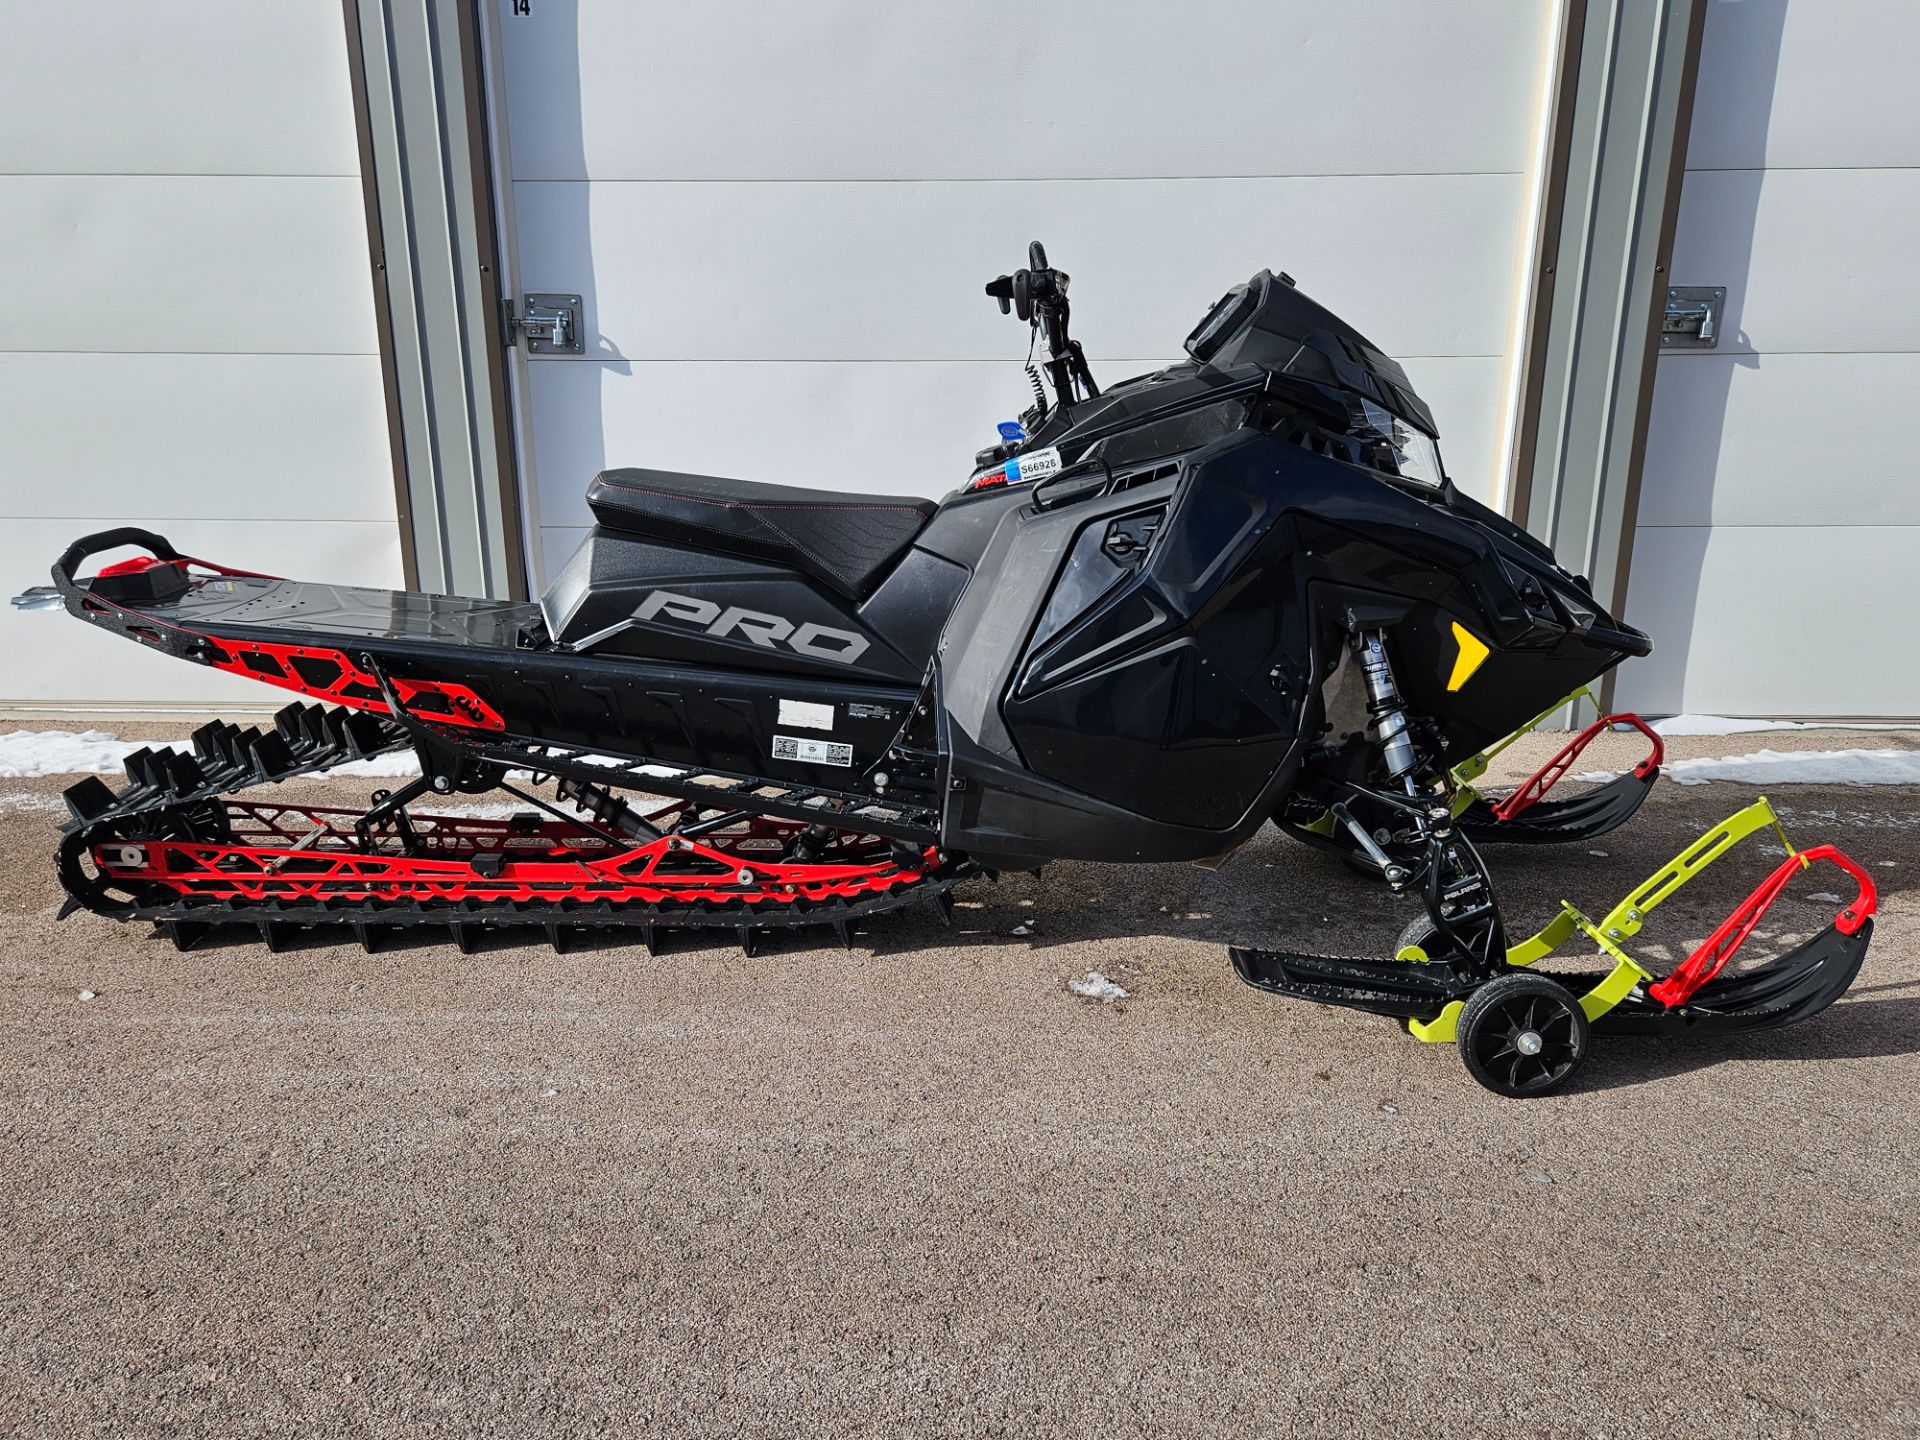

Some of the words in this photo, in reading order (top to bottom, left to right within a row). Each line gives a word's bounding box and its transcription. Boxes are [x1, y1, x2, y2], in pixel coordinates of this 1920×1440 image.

[513, 0, 530, 16] 14
[1020, 458, 1056, 474] S66926
[630, 589, 871, 664] PRO
[1443, 881, 1482, 901] POLARIS
